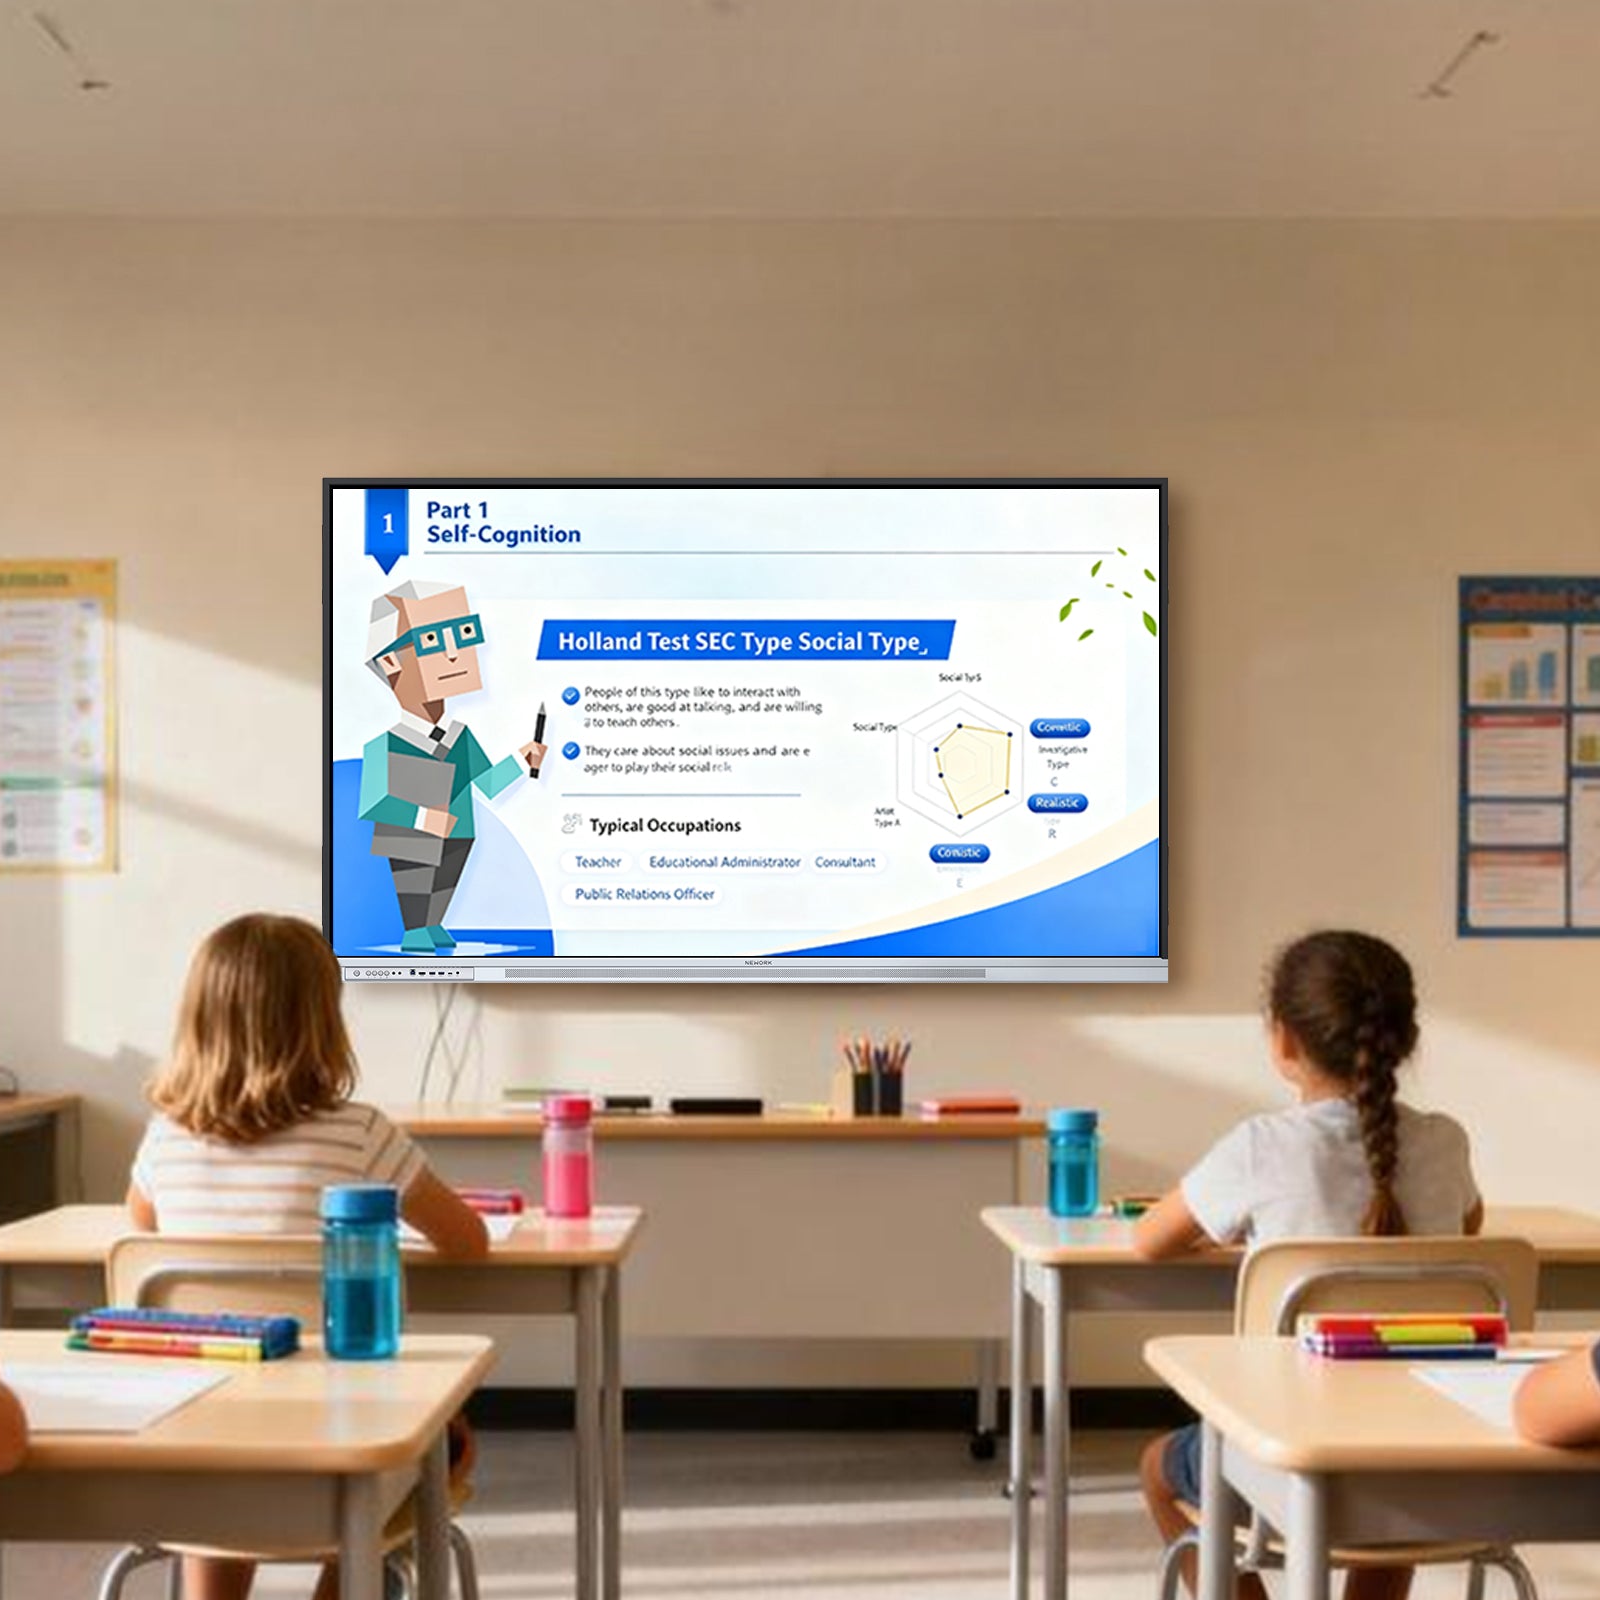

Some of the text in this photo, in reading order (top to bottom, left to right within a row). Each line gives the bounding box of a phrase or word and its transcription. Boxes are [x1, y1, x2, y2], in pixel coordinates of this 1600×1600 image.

[427, 501, 487, 519] Part 1
[382, 513, 394, 534] 1
[428, 524, 581, 548] Self-Cognition
[560, 632, 641, 650] Holland
[647, 632, 690, 650] Test
[696, 632, 735, 650] SEC
[741, 632, 792, 655] Type
[799, 631, 862, 650] Social
[585, 686, 801, 700] People of this type like to interact with
[585, 702, 623, 713] others,
[626, 704, 644, 712] are
[647, 701, 676, 715] good
[679, 703, 691, 712] at
[738, 701, 760, 712] and
[764, 704, 782, 712] are
[785, 701, 823, 715] willing
[593, 718, 605, 728] to
[607, 717, 637, 727] teach
[853, 722, 898, 733] Social Type
[585, 745, 810, 758] They care about social issues and are e
[584, 764, 609, 776] ager
[611, 763, 623, 772] to
[625, 762, 649, 774] play
[651, 762, 676, 773] their
[678, 761, 710, 773] social
[1047, 759, 1069, 770] Type
[1050, 777, 1058, 787] C
[1037, 797, 1078, 807] Realistic
[590, 818, 741, 836] Typical Occupations
[875, 818, 893, 828] Type
[1048, 828, 1056, 838] R
[575, 856, 621, 868] Teacher
[650, 856, 801, 868] Educational Administrator
[815, 856, 875, 868] Consultant
[575, 888, 715, 900] Public Relations Officer
